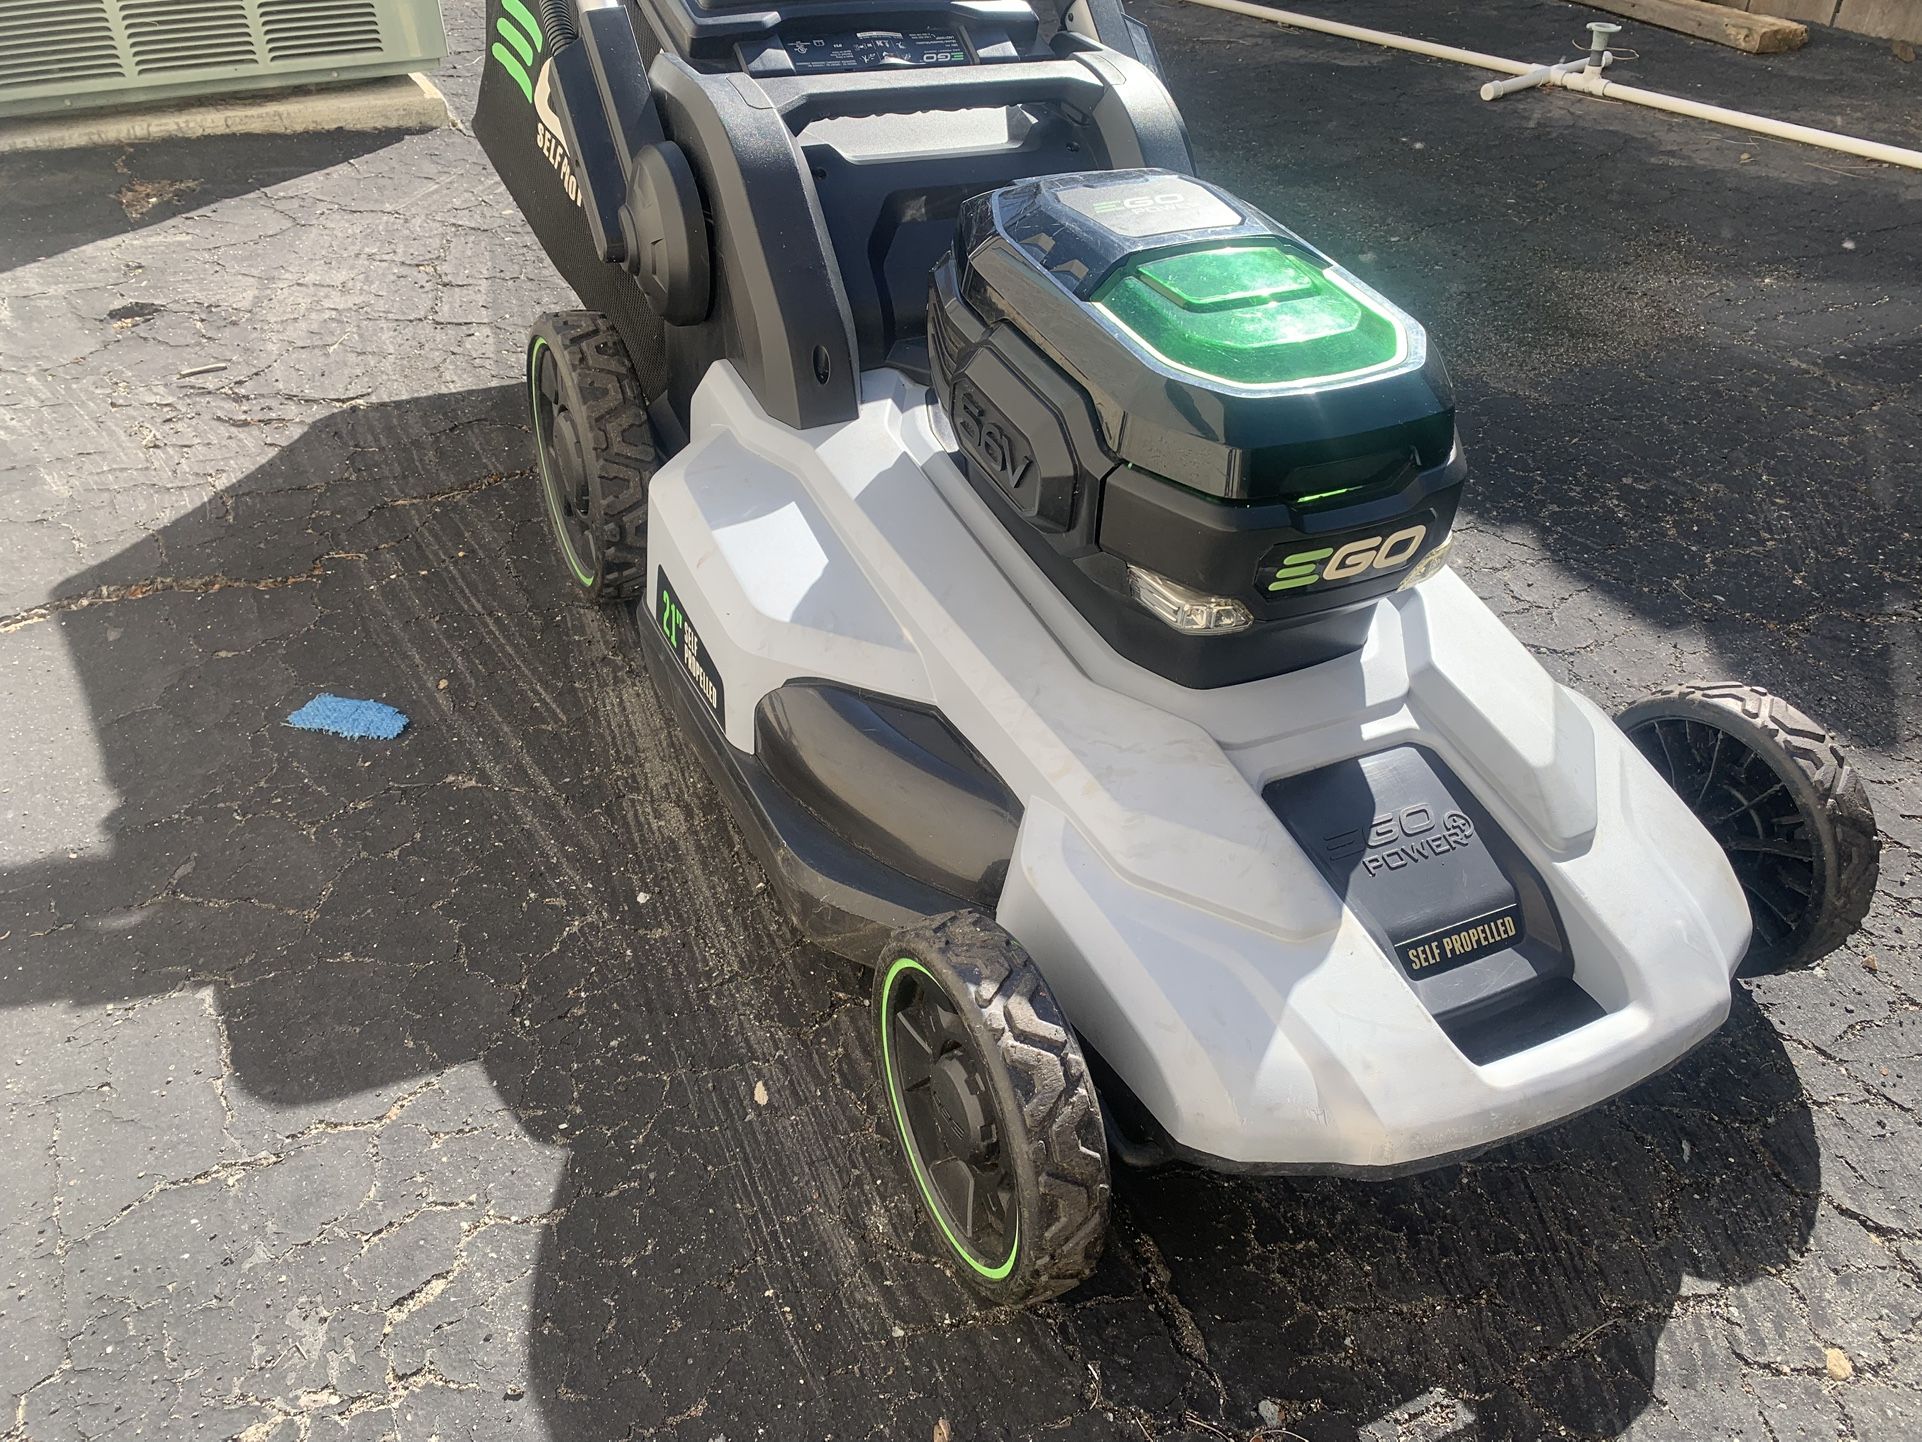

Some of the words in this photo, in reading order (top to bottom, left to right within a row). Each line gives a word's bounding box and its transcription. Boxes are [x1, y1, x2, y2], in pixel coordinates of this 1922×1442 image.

[923, 51, 964, 63] EGO
[536, 122, 564, 170] SELF
[1092, 193, 1185, 214] EGO
[959, 392, 1034, 489] 56V
[1267, 524, 1427, 592] EGO
[683, 621, 699, 657] SELF
[684, 643, 718, 710] PROPELLED
[1322, 802, 1436, 862] EGO
[1408, 942, 1442, 971] SELF
[1442, 915, 1517, 959] PROPELLED
